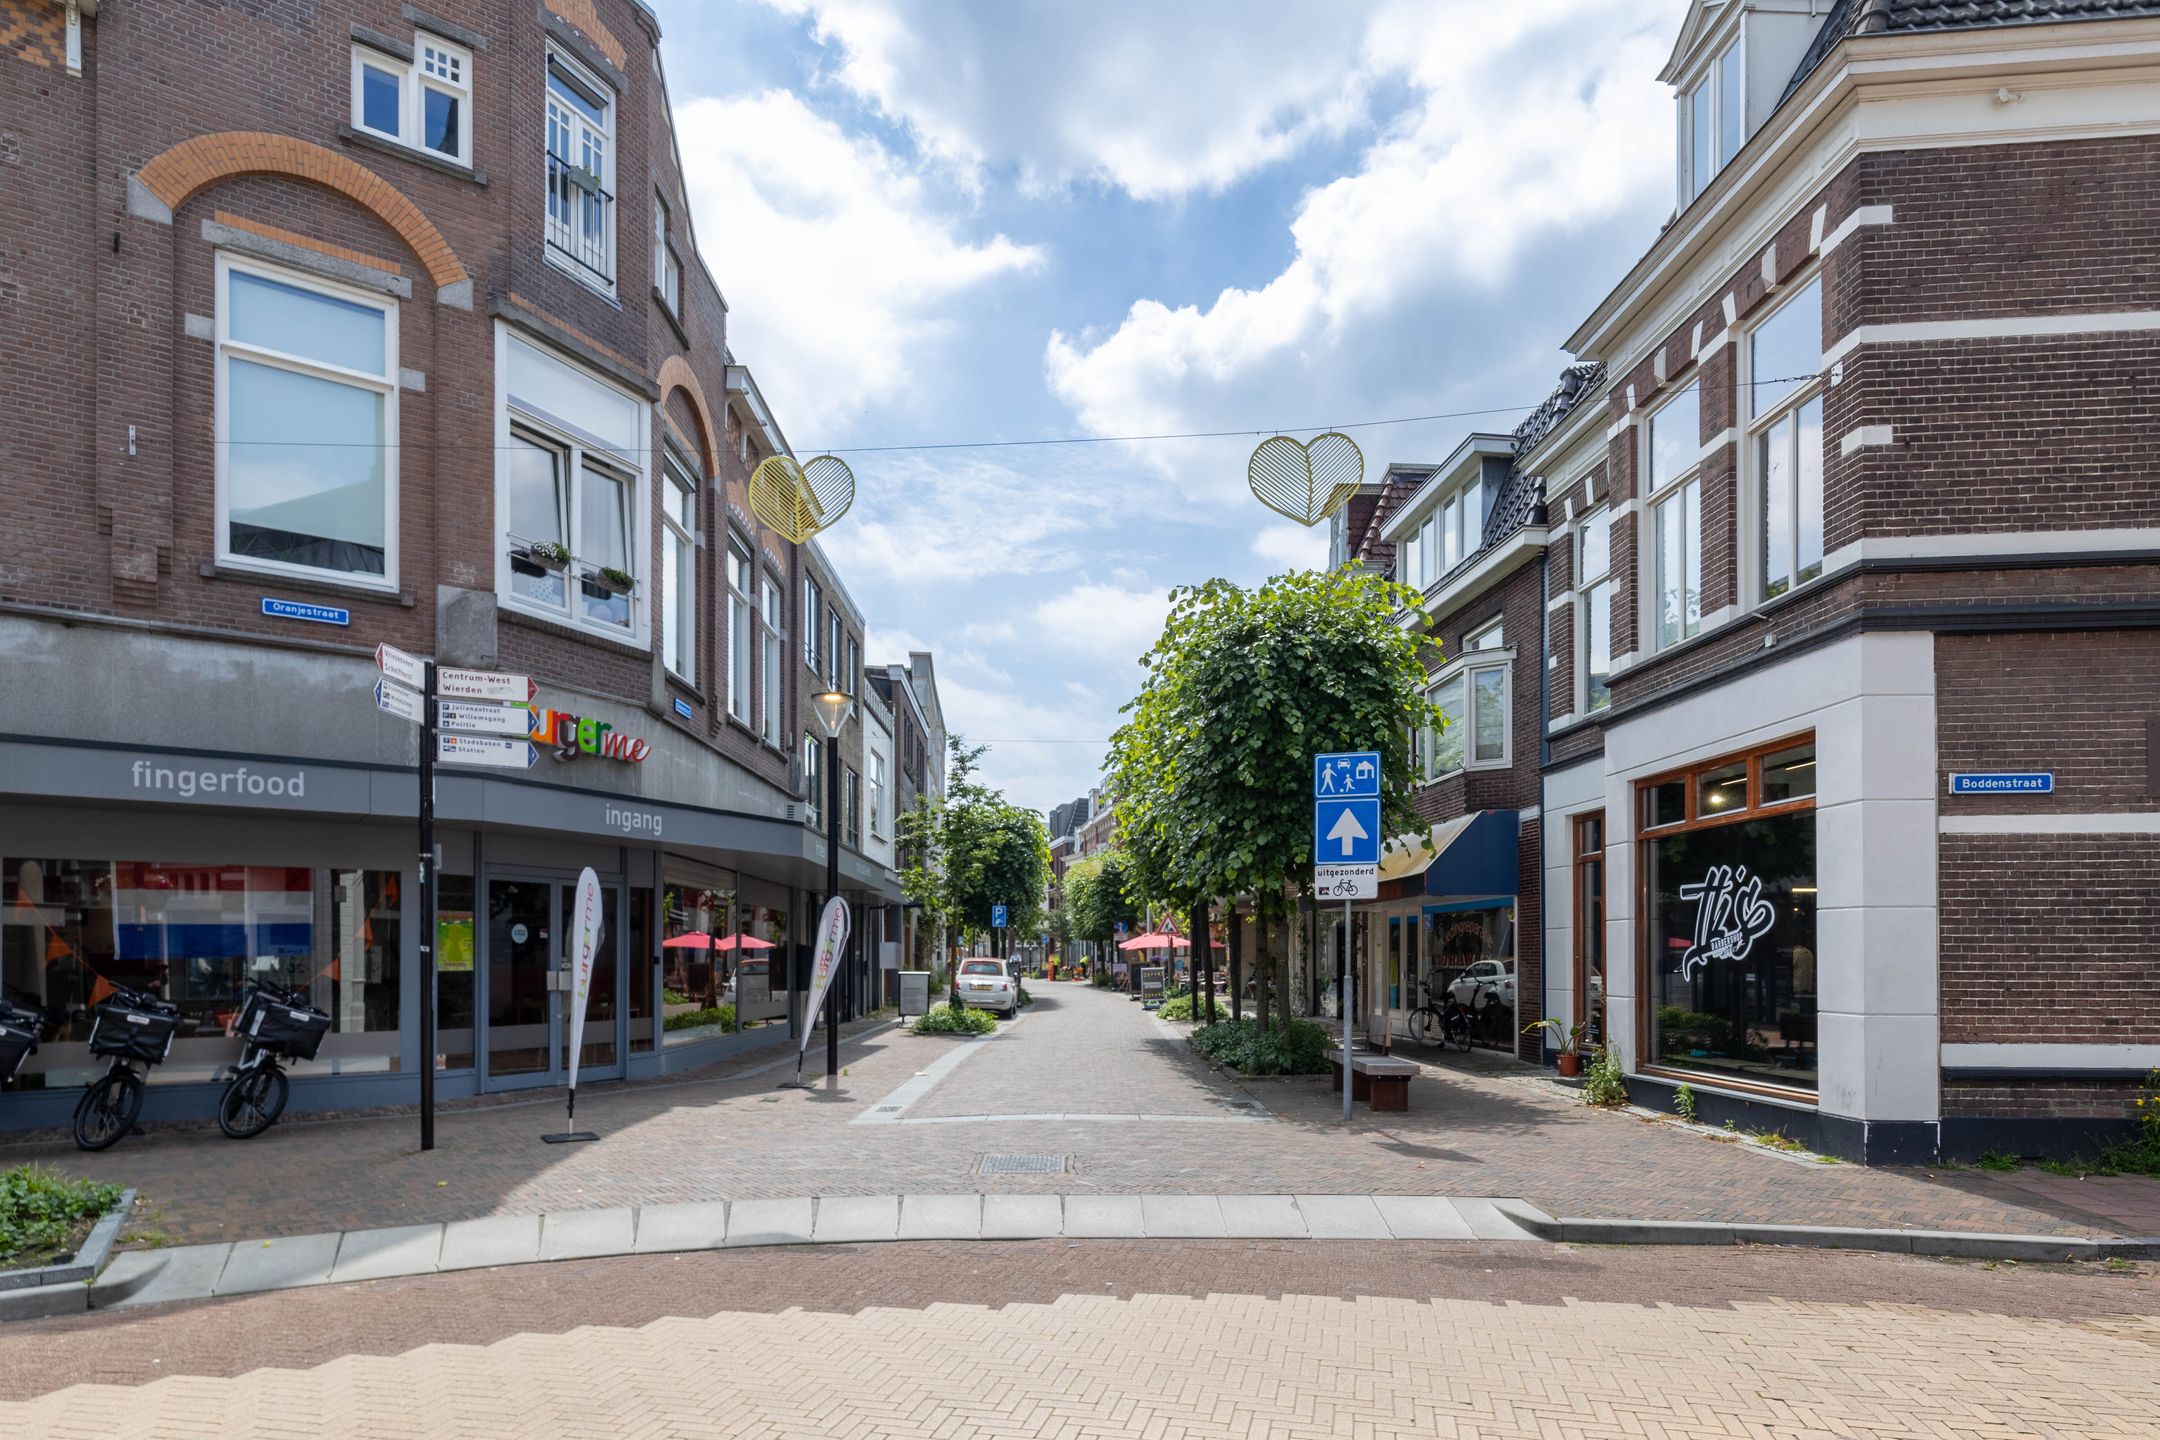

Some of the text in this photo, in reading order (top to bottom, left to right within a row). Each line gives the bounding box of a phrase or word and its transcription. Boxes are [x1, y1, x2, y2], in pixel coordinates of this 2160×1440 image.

[273, 603, 339, 619] Oranjestraat
[442, 671, 511, 684] Centrum-West
[443, 684, 482, 694] Wierden
[451, 703, 501, 714] Julianastraat
[458, 713, 506, 723] Willemsgang
[510, 702, 652, 762] urgerme
[458, 746, 485, 754] Station
[132, 760, 305, 797] fingerfood
[1962, 778, 2043, 788] Boddenstraat
[605, 803, 662, 836] ingang
[1317, 867, 1374, 878] uitgezonderd
